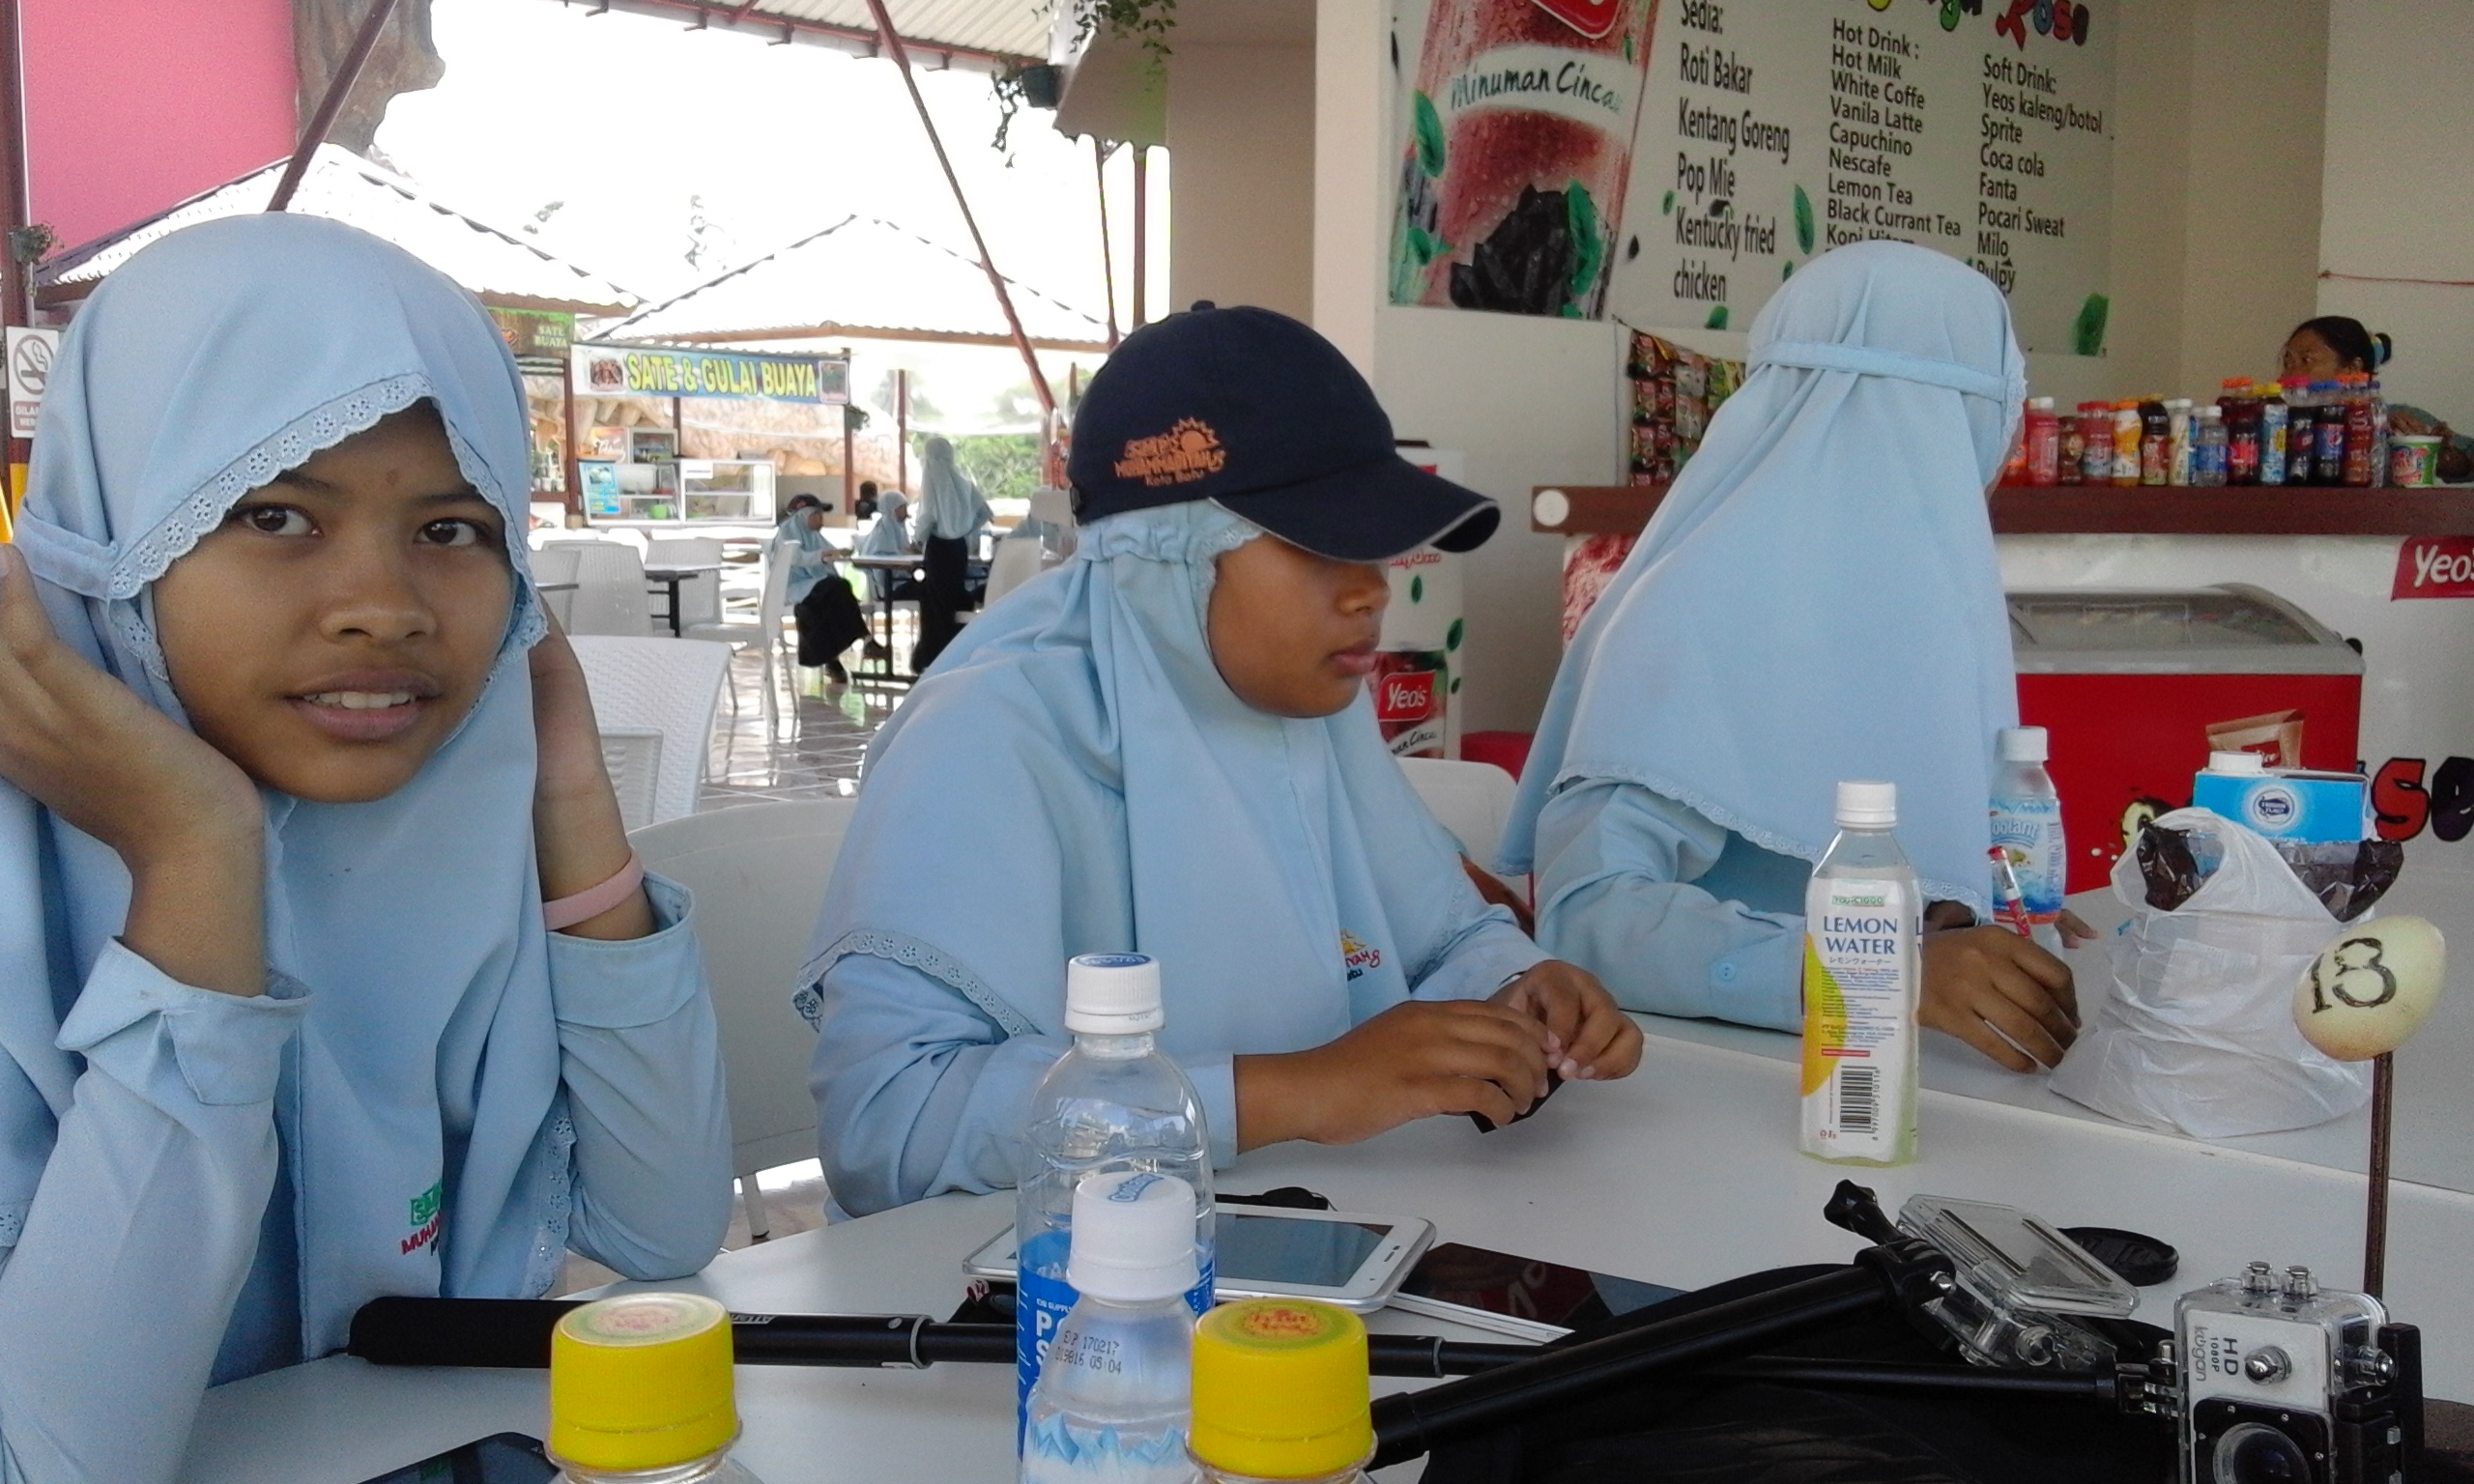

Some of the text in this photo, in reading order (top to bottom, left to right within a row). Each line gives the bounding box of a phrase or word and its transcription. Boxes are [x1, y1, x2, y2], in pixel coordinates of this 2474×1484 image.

[1833, 17, 1863, 45] Hot
[1868, 27, 1911, 57] Drink
[1681, 42, 1753, 95] Roti Bakar
[1832, 43, 1902, 79] Hot Milk
[1983, 53, 2012, 84] Soft
[1451, 63, 1550, 110] Minuman
[1831, 69, 1925, 110] White Coffe
[1830, 95, 1923, 133] Vanila Latte
[1983, 82, 2103, 134] Yeos kaleng/botol
[1679, 97, 1790, 165] Kentang Goreng
[1829, 122, 1913, 156] Capuchino
[1981, 113, 2023, 145] Sprite
[1678, 152, 1736, 205] Pop Mie
[1829, 147, 1892, 177] Nescafe
[1980, 143, 2045, 177] Coca cola
[1828, 172, 1913, 205] Lemon Tea
[1979, 172, 2018, 201] Fanta
[1676, 206, 1775, 262] Kentucky fried
[1827, 198, 1961, 236] Black Currant Tea
[1978, 202, 2065, 238] Pocari Sweat
[1977, 231, 2009, 257] Milo
[1674, 258, 1726, 301] chicken
[626, 353, 817, 397] SATE & GULAI BUAYA
[2413, 544, 2474, 588] Yeo
[1387, 682, 1427, 711] Yeo's
[1991, 818, 2039, 839] oolant
[1824, 916, 1898, 934] LEMON
[1825, 936, 1896, 955] WATER
[2192, 1327, 2209, 1382] kogan
[2223, 1336, 2239, 1376] HD
